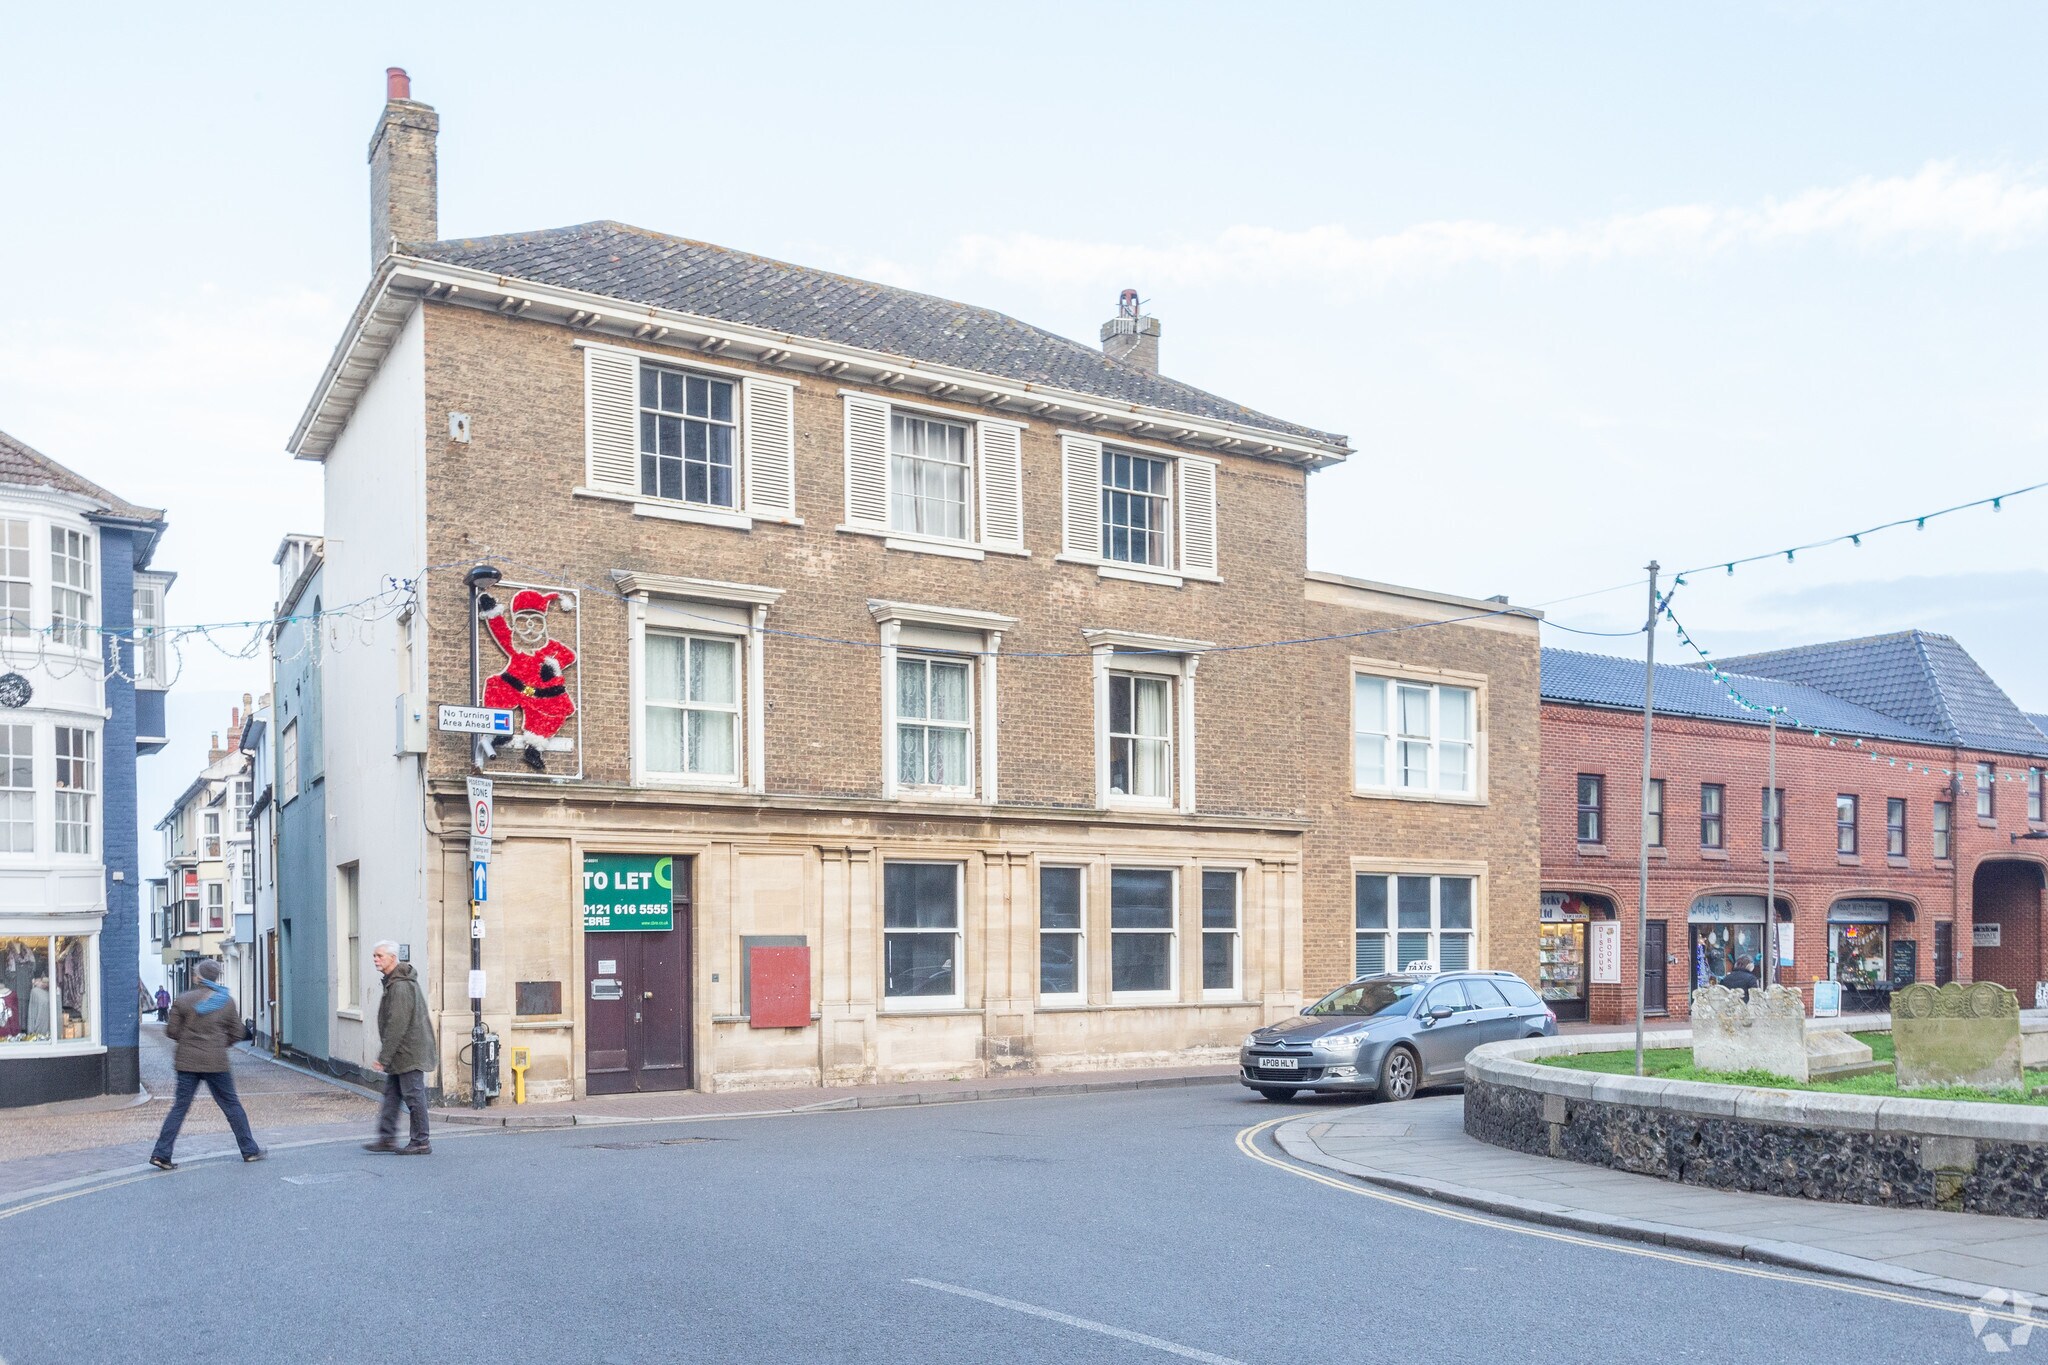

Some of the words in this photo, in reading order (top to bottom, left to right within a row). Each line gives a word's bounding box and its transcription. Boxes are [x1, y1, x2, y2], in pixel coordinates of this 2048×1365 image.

[444, 709, 456, 717] No
[459, 710, 490, 720] Turning
[443, 718, 462, 726] Area
[465, 720, 491, 729] Ahead
[468, 778, 491, 787] PEDESTRIAN
[472, 787, 488, 798] ZONE
[583, 871, 608, 890] TO
[614, 871, 652, 890] LET
[1541, 895, 1560, 905] ooks
[584, 904, 610, 915] 0121
[614, 904, 637, 915] 616
[639, 904, 668, 915] 5555
[1262, 1059, 1280, 1067] AP08
[1281, 1059, 1294, 1068] HLY
